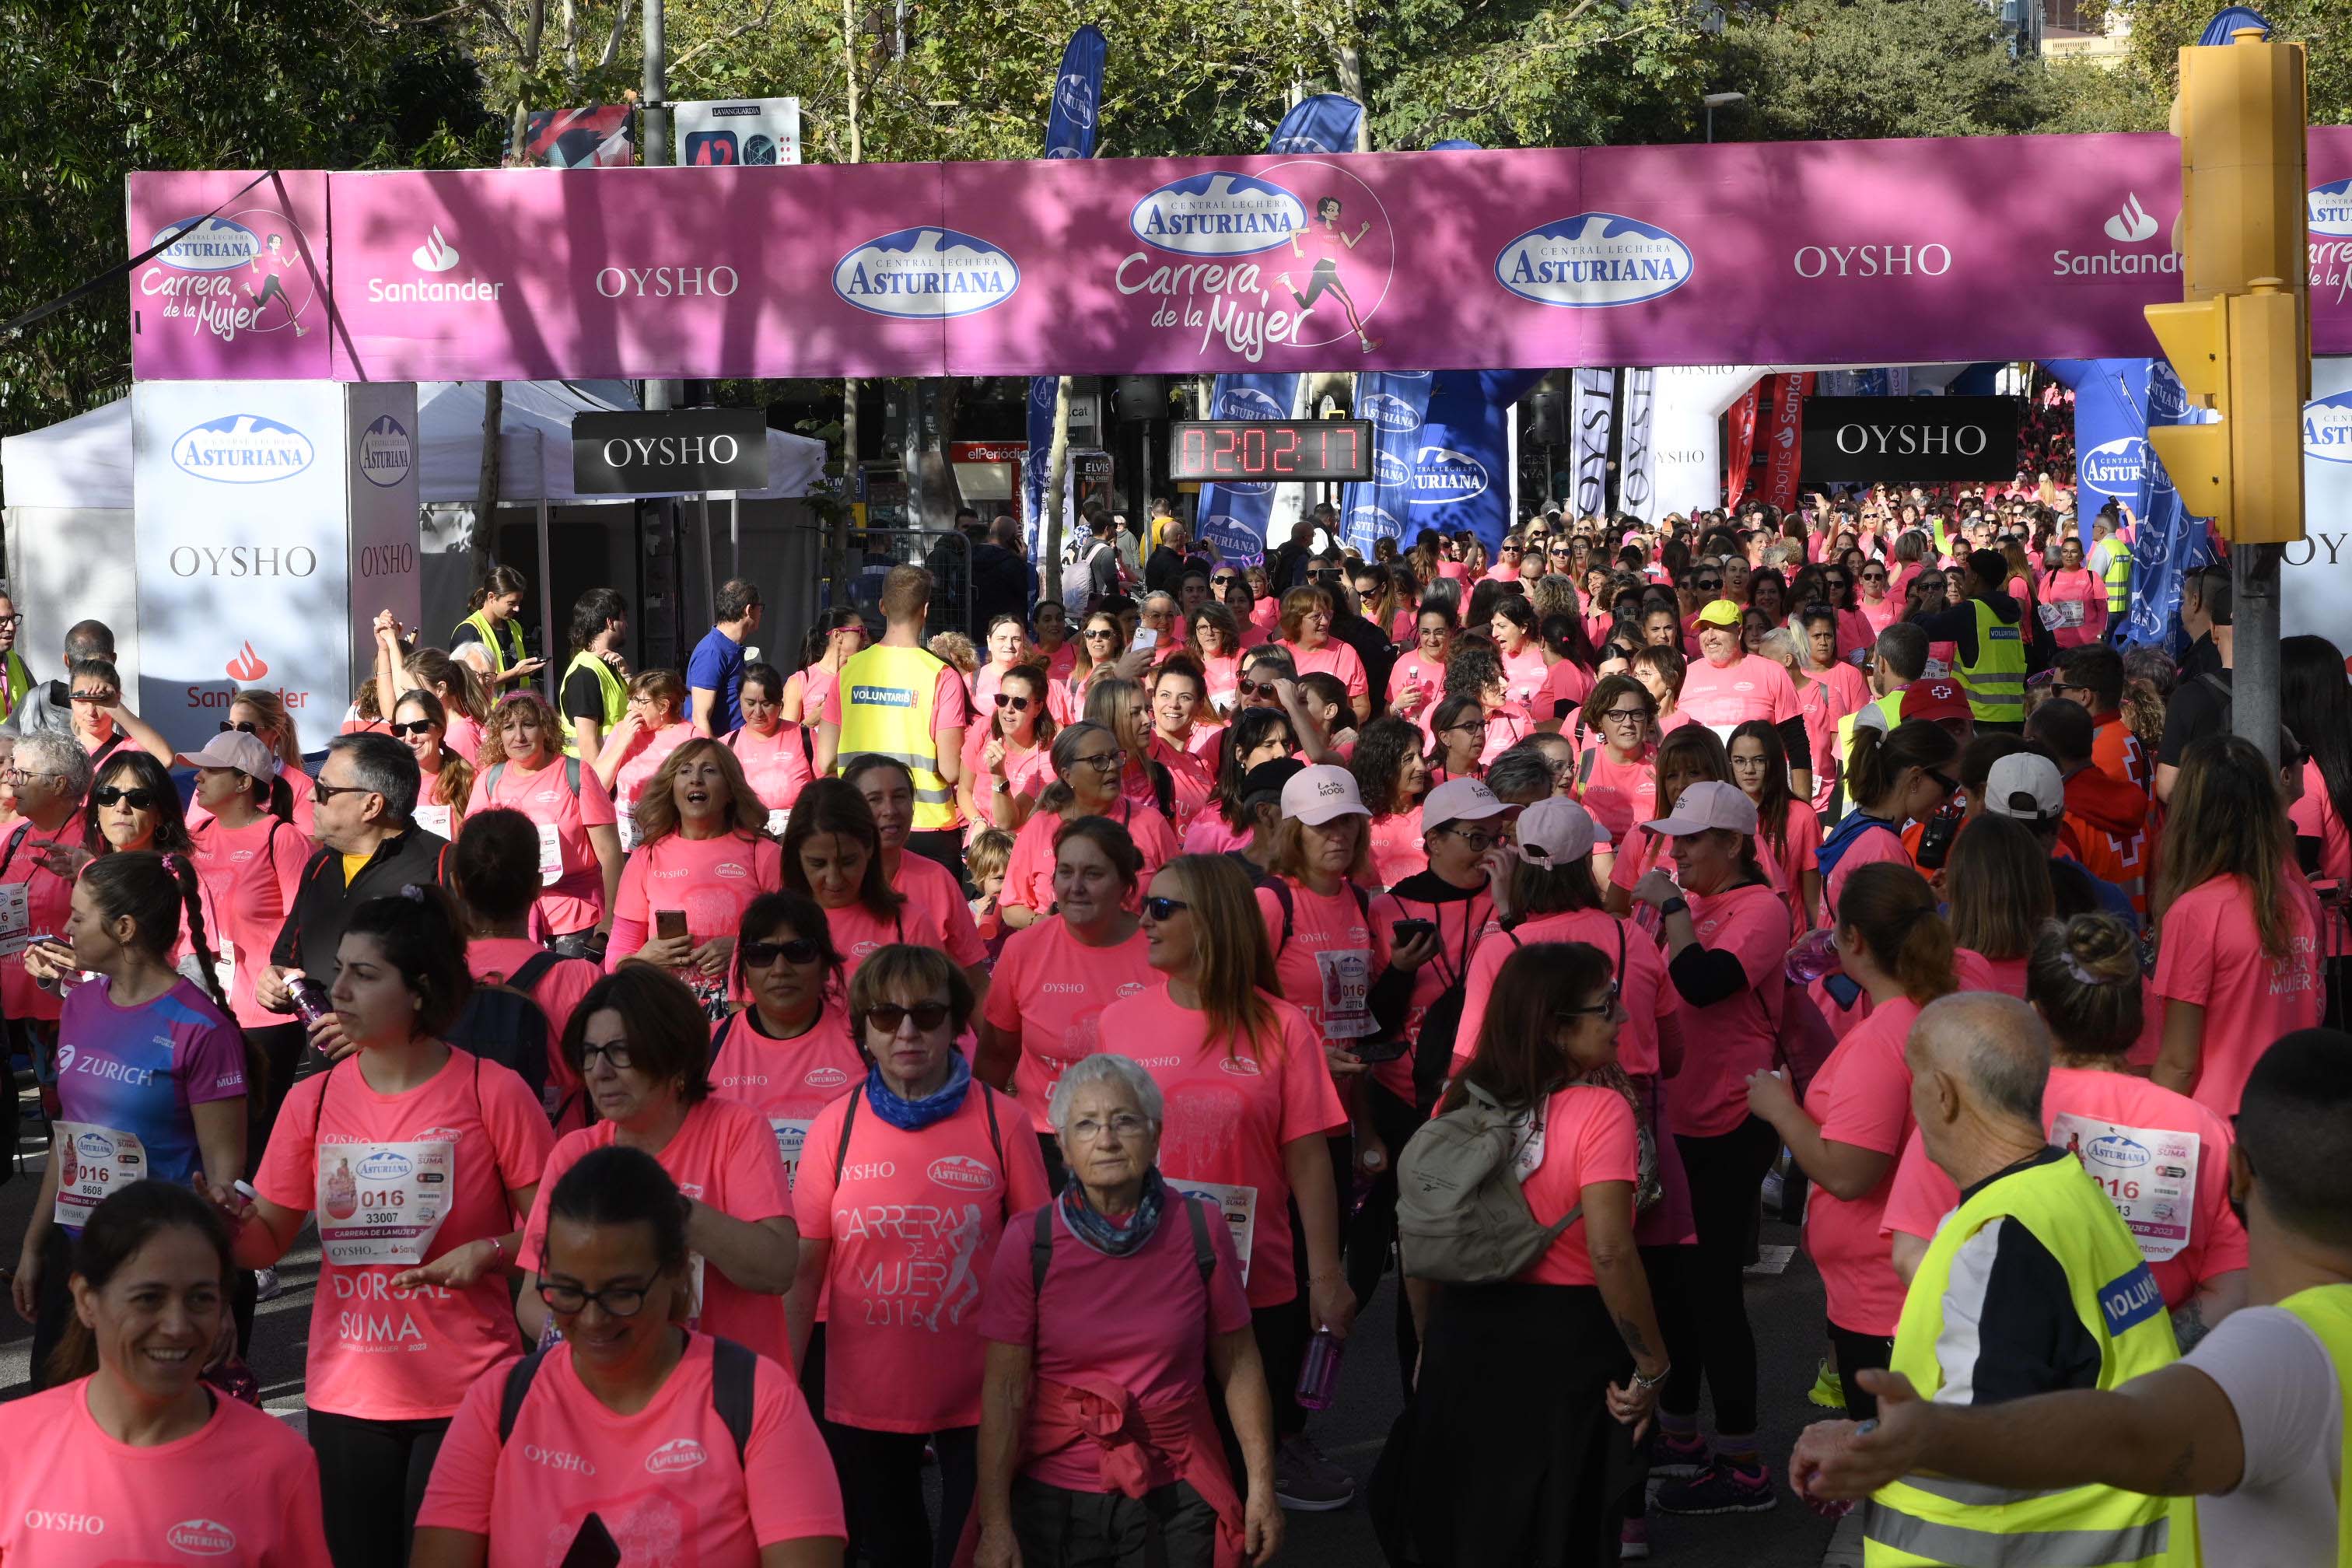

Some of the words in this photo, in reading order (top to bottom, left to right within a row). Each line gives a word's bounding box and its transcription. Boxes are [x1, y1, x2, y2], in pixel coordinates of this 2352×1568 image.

[1171, 201, 1227, 209] CENTRAL
[1233, 200, 1288, 209] LECHERA
[1144, 204, 1293, 235] ASTURIANA
[1541, 246, 1604, 256] CENTRAL
[1608, 243, 1671, 254] LECHERA
[1794, 243, 1952, 278] OYSHO
[875, 258, 934, 268] CENTRAL
[940, 257, 999, 267] LECHERA
[1115, 252, 1261, 296] Carrera
[1510, 249, 1678, 285] ASTURIANA
[2053, 250, 2183, 277] Santand
[140, 268, 233, 296] Carrera
[595, 266, 739, 298] OYSHO
[846, 261, 1003, 296] ASTURIANA
[2326, 264, 2340, 286] la
[368, 278, 504, 303] Santander
[163, 297, 180, 318] de
[184, 296, 196, 318] la
[194, 294, 267, 342] Mujer
[1151, 299, 1178, 327] de
[1184, 296, 1203, 327] la
[1199, 289, 1315, 363] Mujer
[1836, 423, 1987, 456] OYSHO
[184, 440, 303, 466] ASTURIANA
[363, 441, 408, 470] ASTURIANA
[603, 435, 739, 468] OYSHO
[1085, 462, 1109, 473] ELVIS
[1770, 451, 1792, 508] Sports
[170, 546, 317, 577] OYSHO
[361, 542, 413, 578] OYSHO
[1319, 787, 1345, 797] MOOD
[653, 868, 689, 878] OYSHO
[1042, 983, 1084, 994] OYSHO
[1342, 984, 1365, 997] 016
[2269, 973, 2312, 996] MUJER
[77, 1055, 154, 1087] ZURICH
[1137, 1056, 1181, 1069] OYSHO
[216, 1073, 243, 1088] MUJE
[723, 1075, 768, 1088] OYSHO
[807, 1074, 844, 1083] ASTURIANA
[2090, 1143, 2145, 1163] ASTURIANA
[2157, 1148, 2186, 1158] SUMA
[79, 1165, 110, 1182] 016
[360, 1164, 408, 1174] ASTURIANA
[840, 1161, 896, 1181] YSHO
[933, 1164, 992, 1187] ASTURIANA
[82, 1185, 103, 1195] 8608
[361, 1190, 405, 1208] 016
[366, 1213, 399, 1224] 33007
[835, 1205, 961, 1242] CARRERA
[334, 1227, 369, 1237] CARRERA
[370, 1227, 380, 1236] DE
[382, 1227, 390, 1235] LA
[392, 1227, 416, 1235] MUJER
[332, 1246, 372, 1257] OYSHO
[858, 1262, 948, 1297] MUJER
[862, 1298, 925, 1327] 2016
[339, 1311, 423, 1342] SUMA
[523, 1444, 597, 1475] OYSHO
[25, 1509, 105, 1535] OYSHO
[173, 1529, 233, 1549] ASTURIANA
